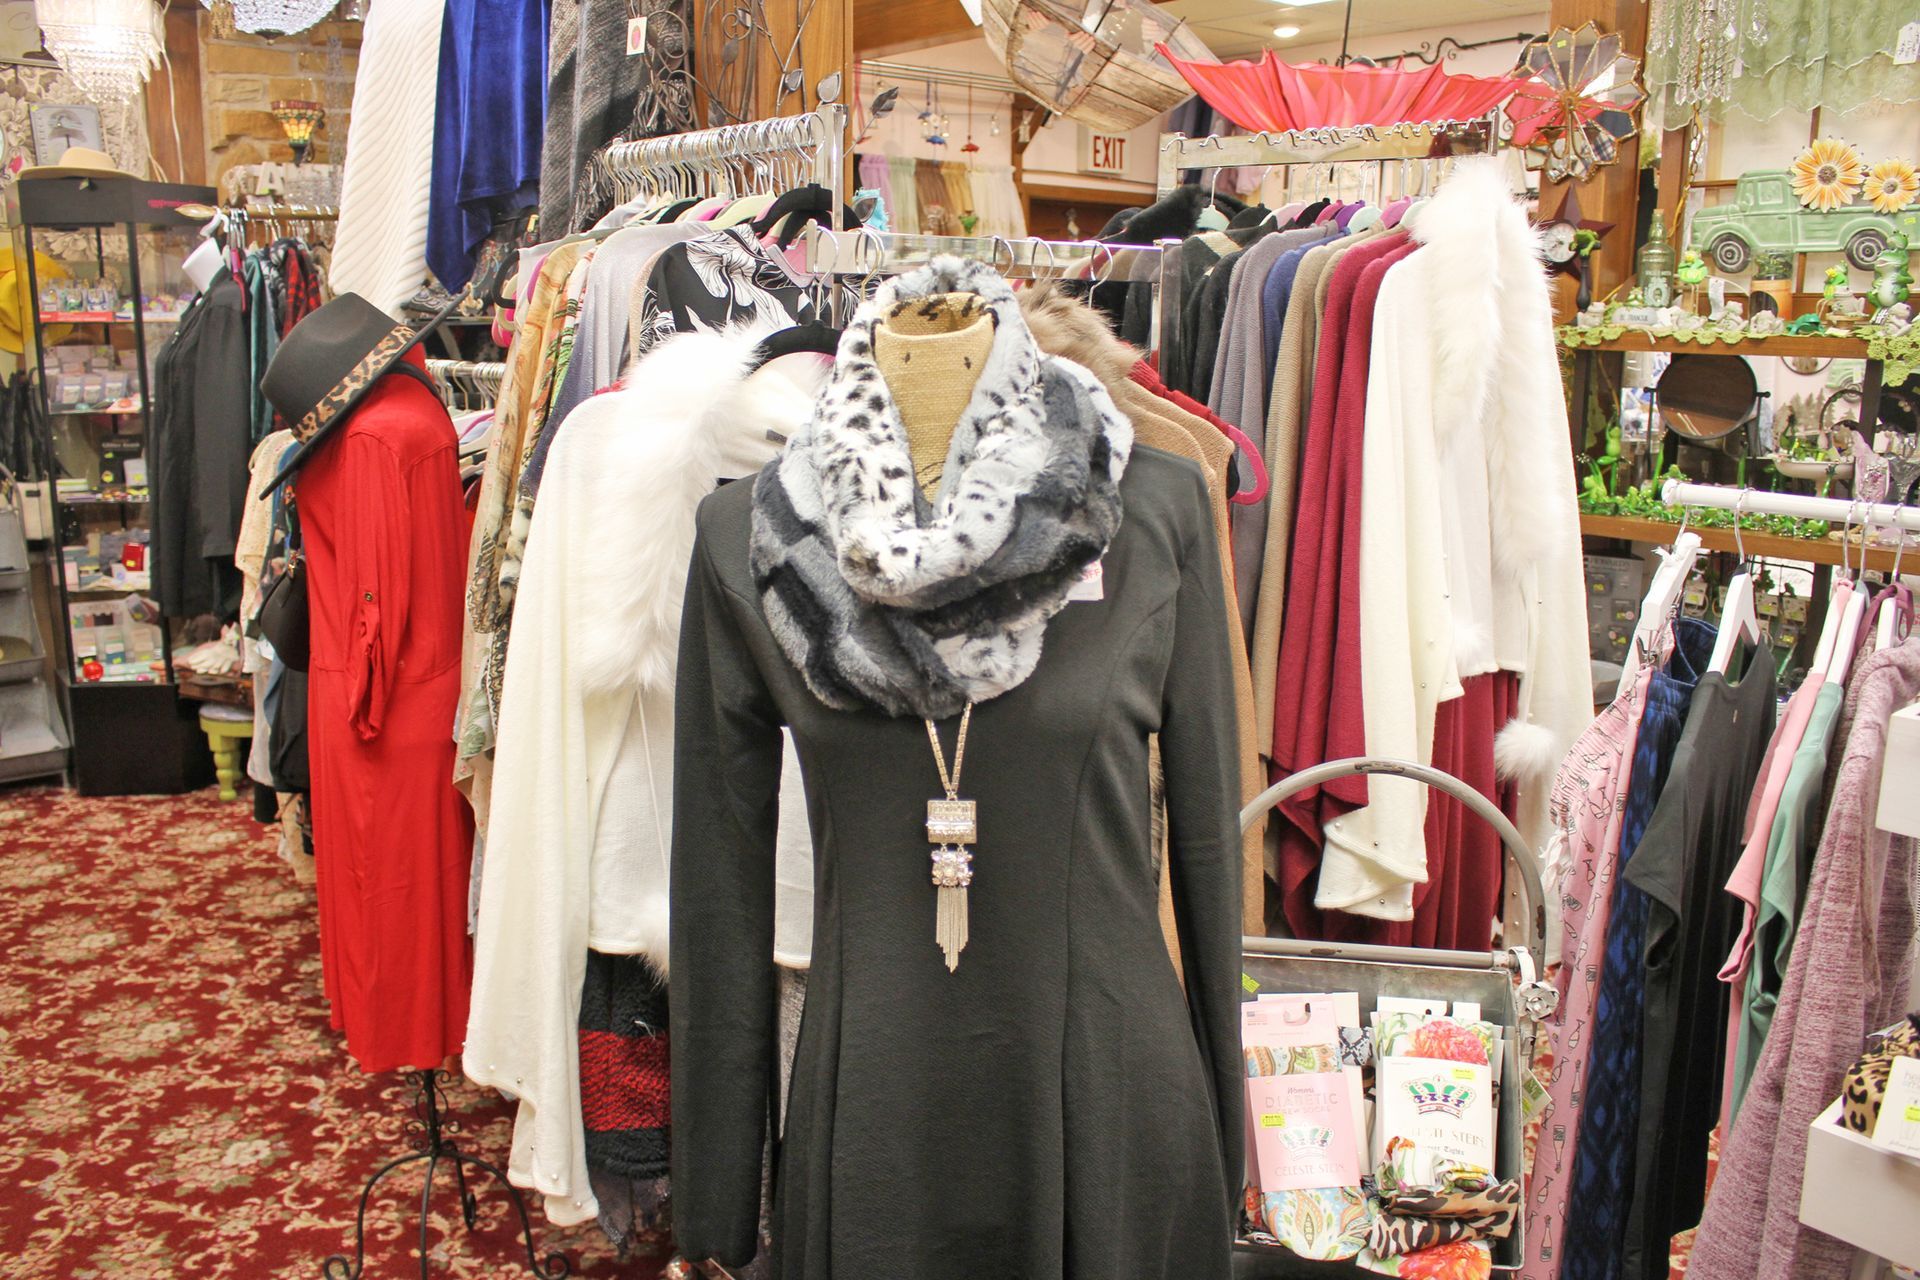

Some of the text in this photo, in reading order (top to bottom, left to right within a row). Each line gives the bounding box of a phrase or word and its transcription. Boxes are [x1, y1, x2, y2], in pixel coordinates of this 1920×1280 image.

[1093, 135, 1126, 170] EXIT
[1264, 1093, 1339, 1109] DIABETIC
[1274, 1164, 1316, 1178] CELESTE
